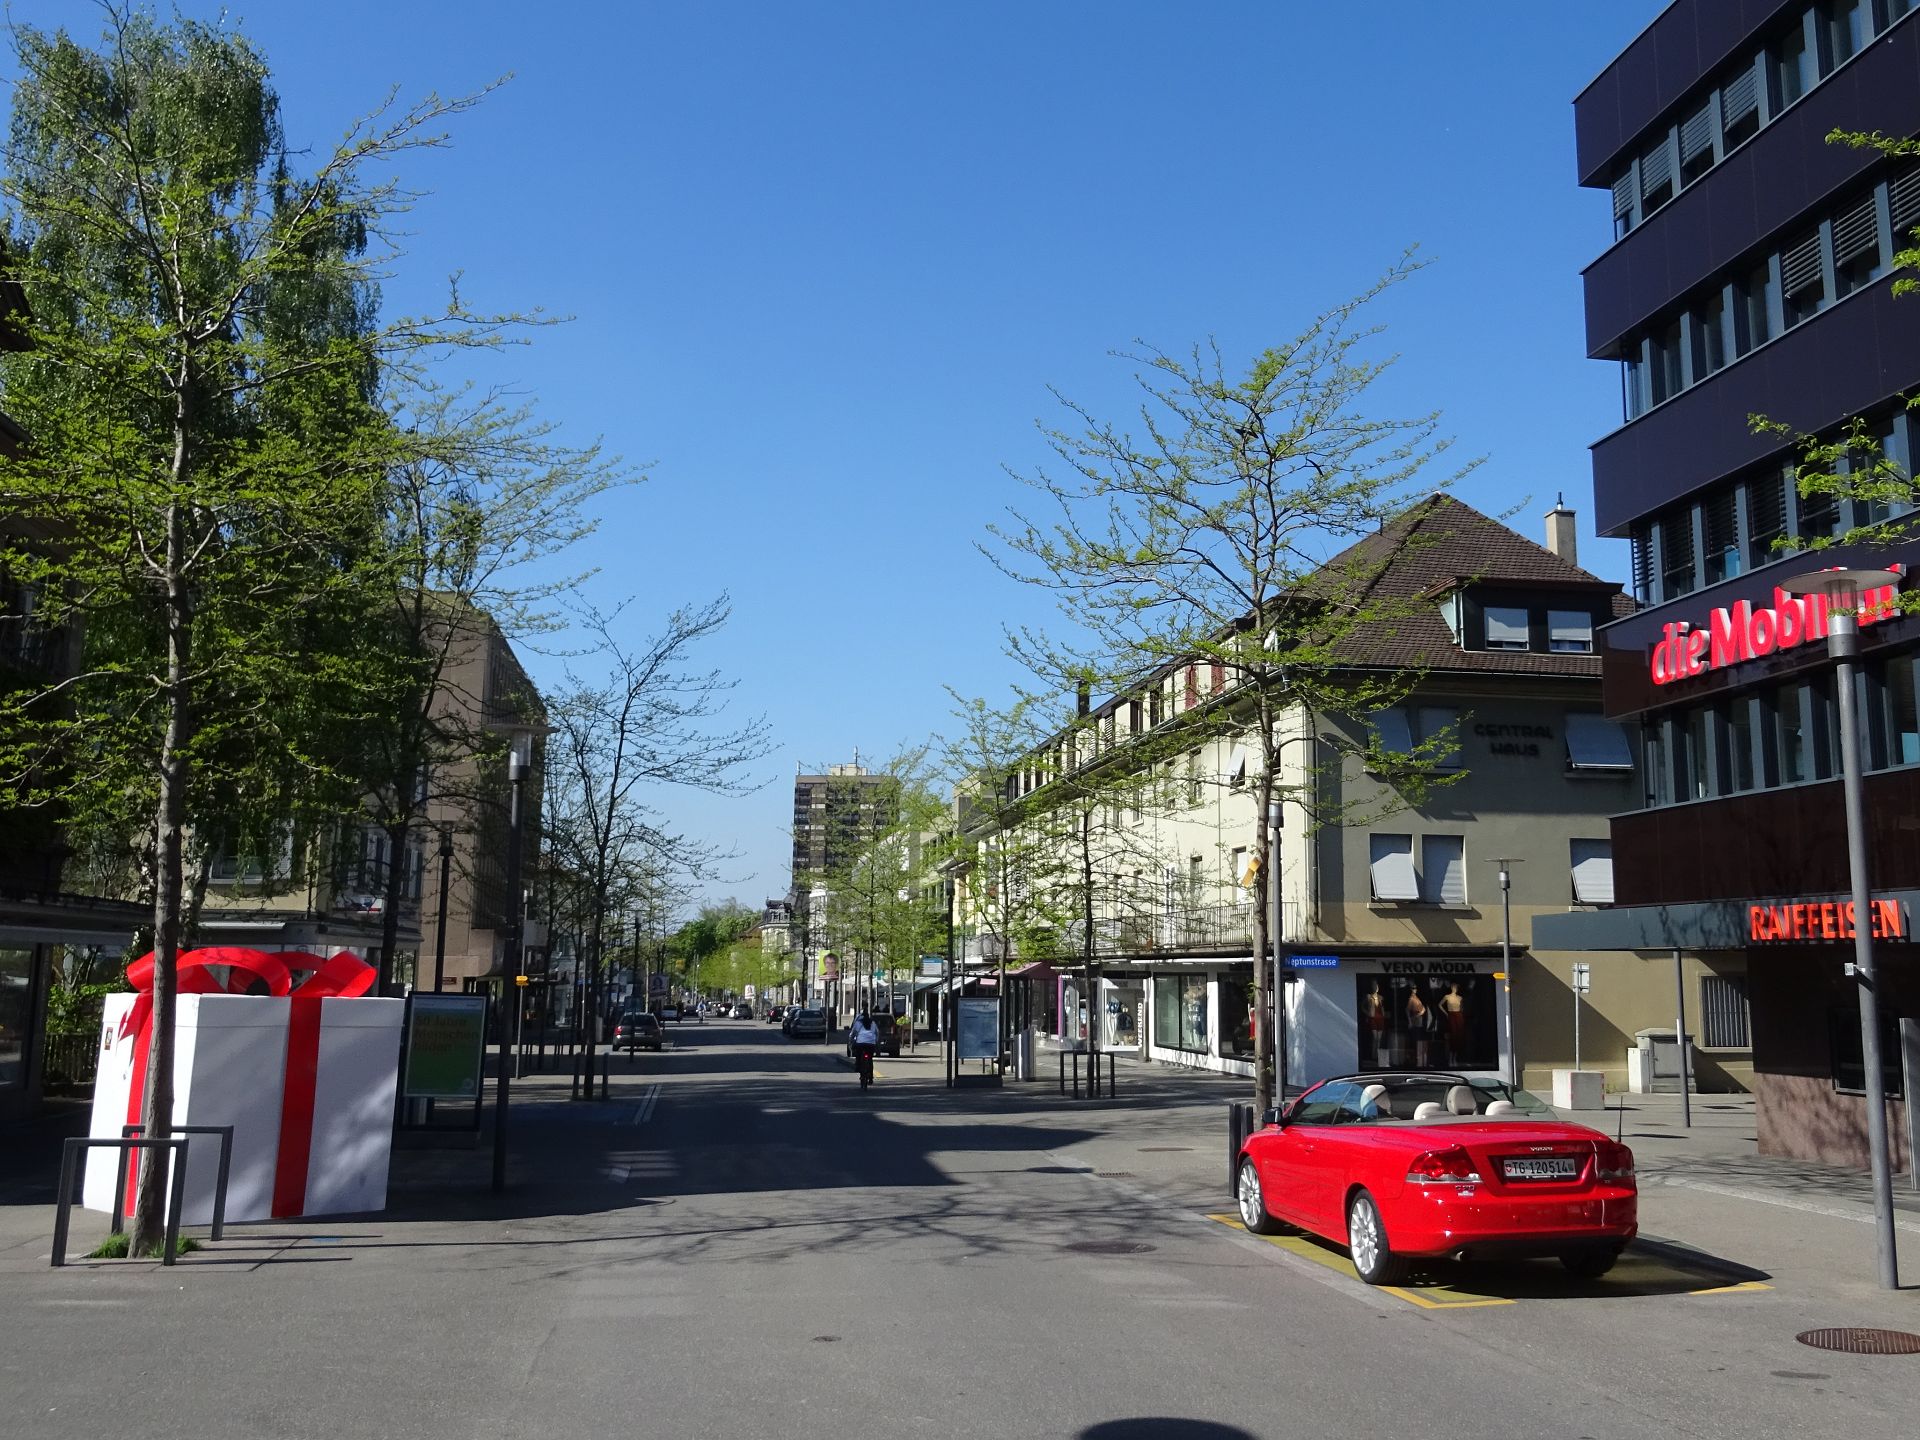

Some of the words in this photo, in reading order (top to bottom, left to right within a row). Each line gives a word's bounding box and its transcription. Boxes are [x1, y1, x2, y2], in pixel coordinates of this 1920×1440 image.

[1473, 723, 1553, 739] CENTRAL
[1490, 742, 1540, 757] HAUS
[1285, 957, 1337, 968] Neptunstrasse
[1381, 961, 1424, 973] VERO
[1428, 961, 1476, 973] MODA
